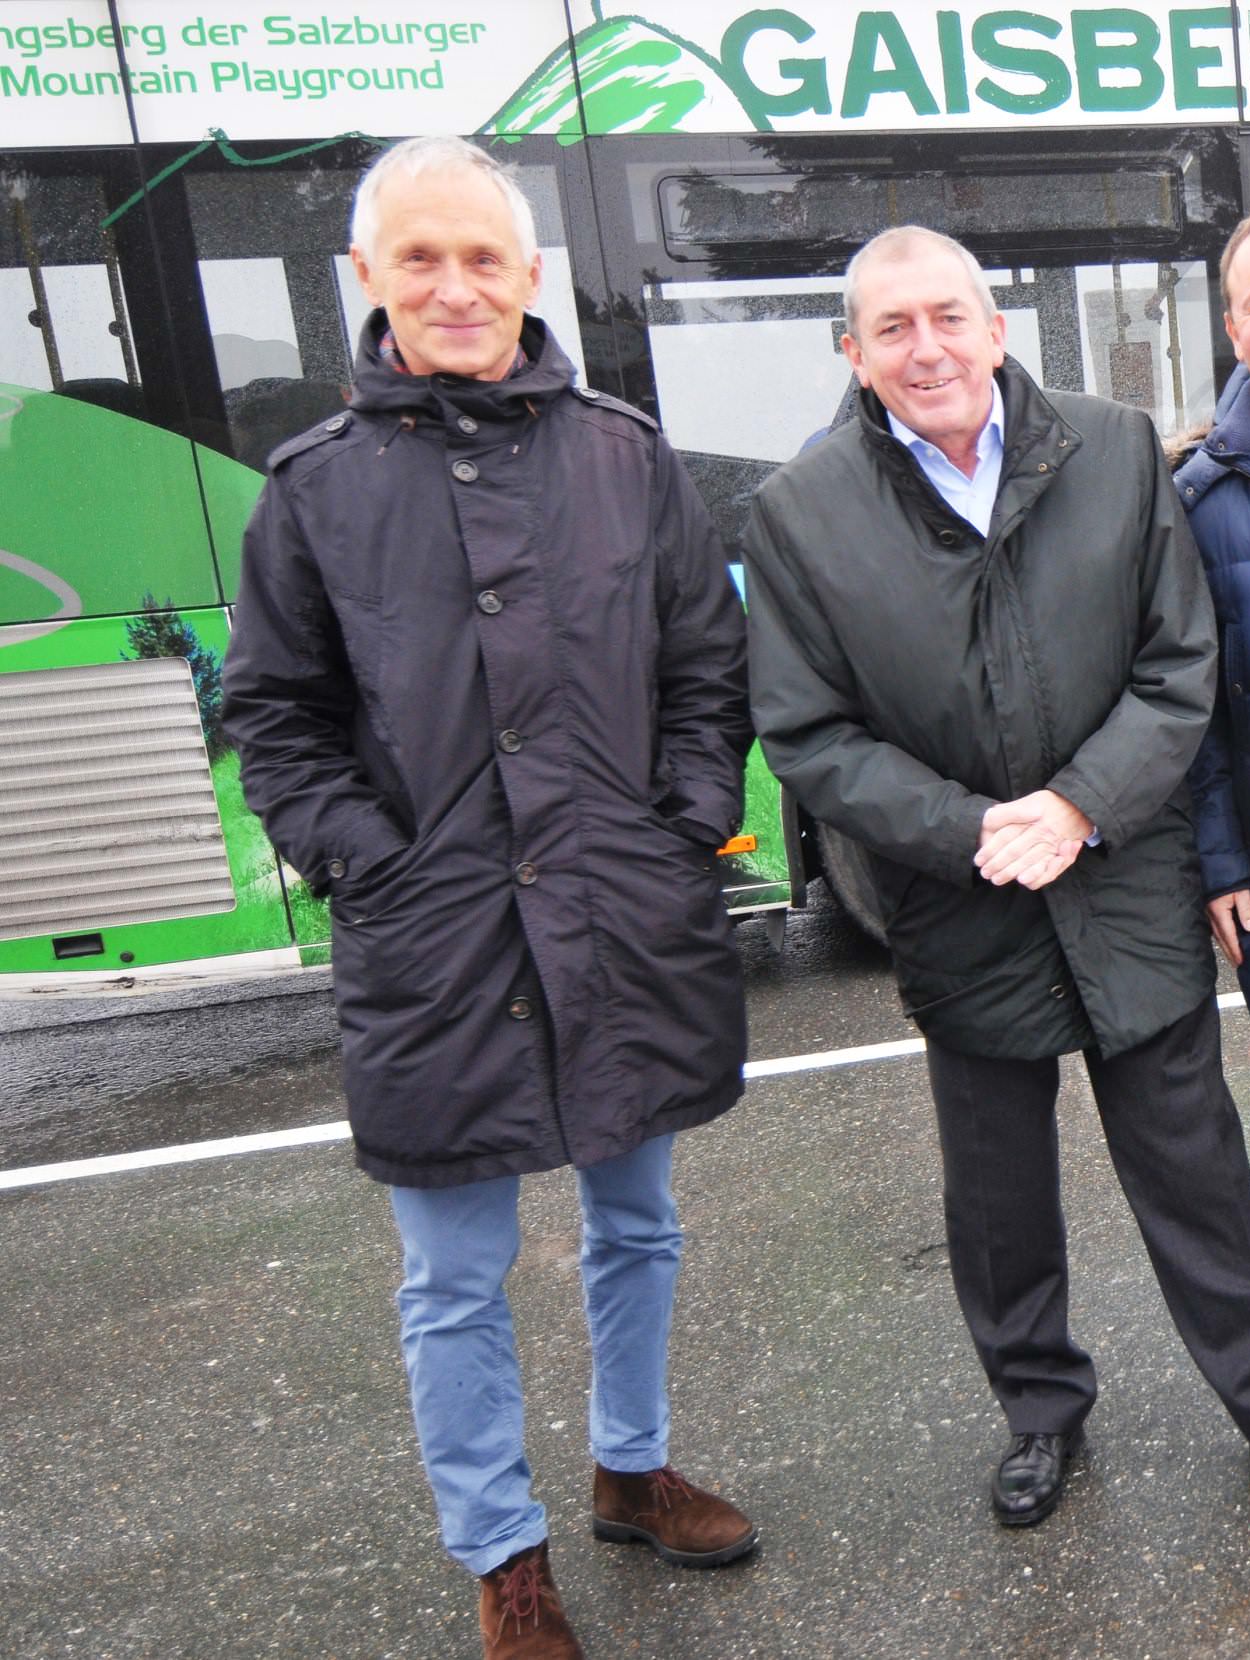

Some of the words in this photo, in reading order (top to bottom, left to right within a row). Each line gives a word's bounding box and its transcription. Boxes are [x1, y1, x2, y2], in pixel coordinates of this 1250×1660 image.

[181, 16, 249, 46] der
[263, 15, 487, 52] Salzburger
[0, 63, 198, 97] Mountain
[210, 60, 444, 100] Playground
